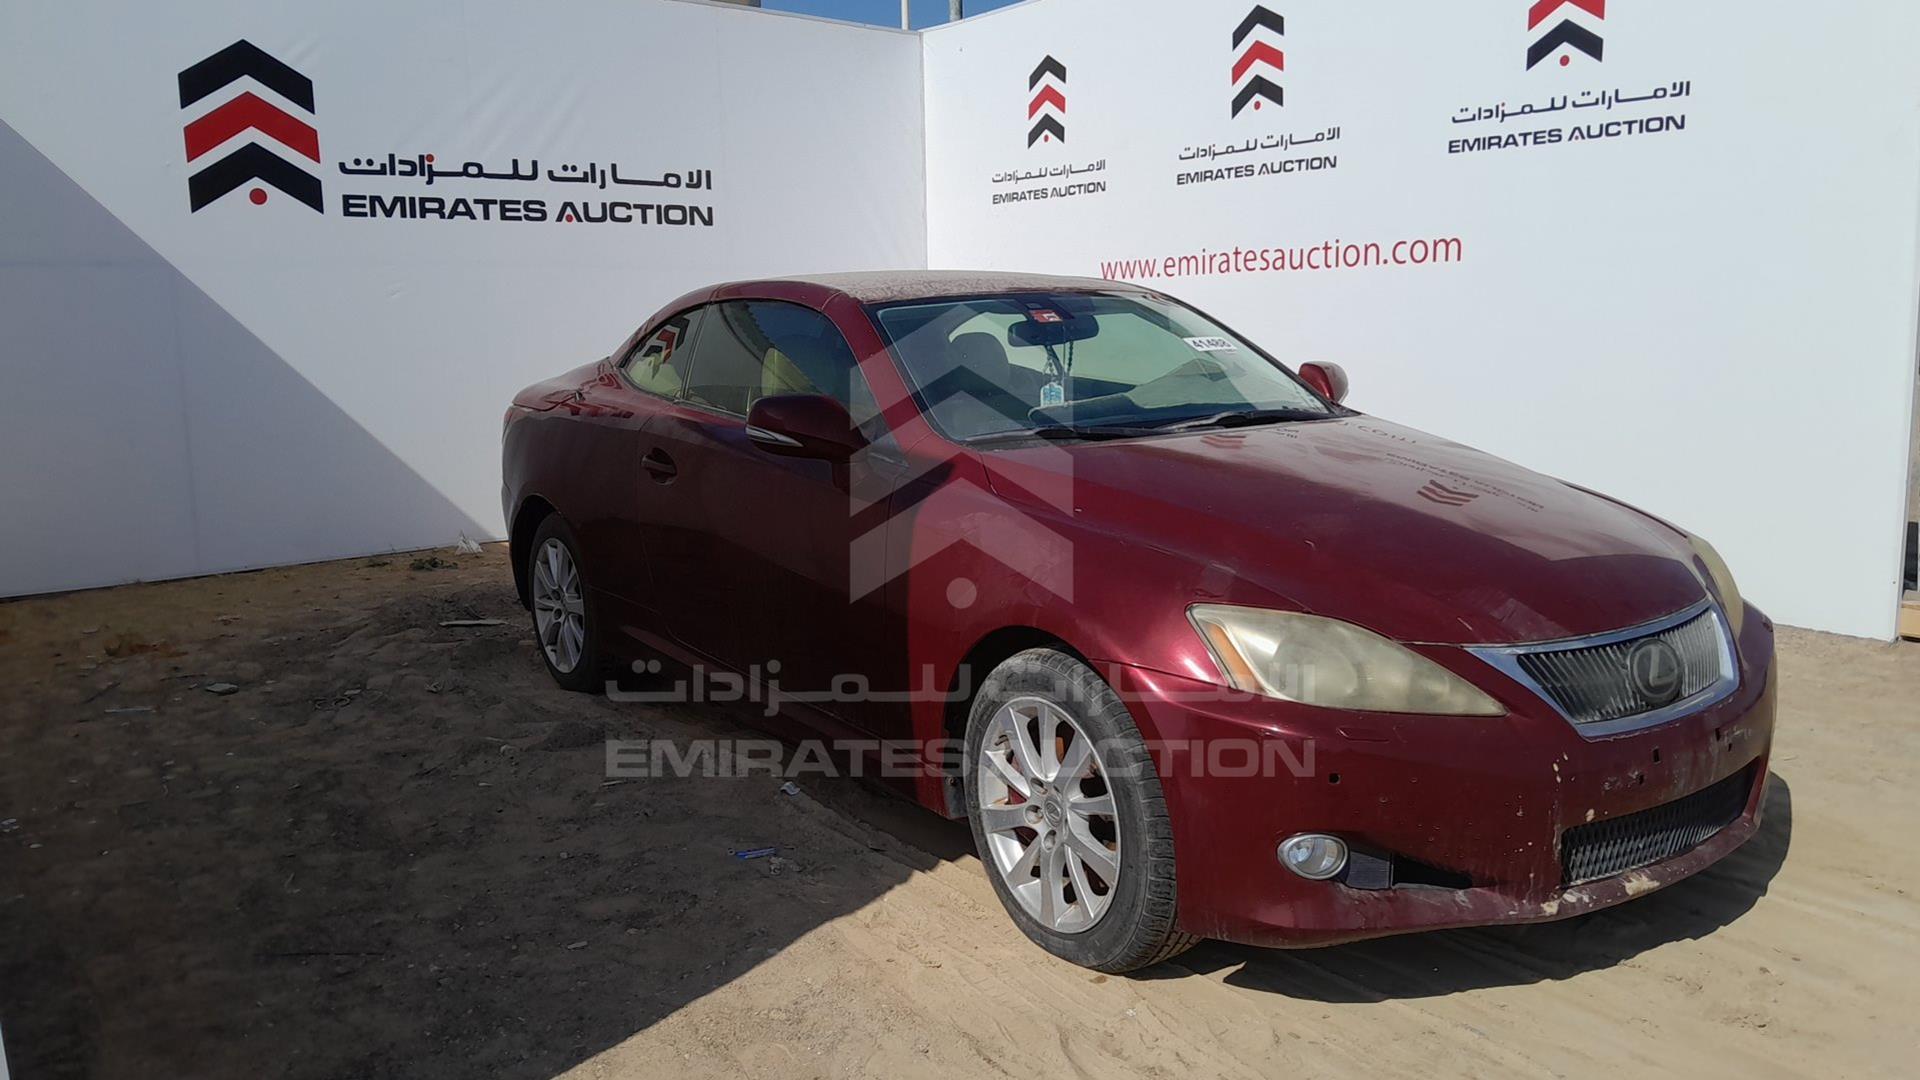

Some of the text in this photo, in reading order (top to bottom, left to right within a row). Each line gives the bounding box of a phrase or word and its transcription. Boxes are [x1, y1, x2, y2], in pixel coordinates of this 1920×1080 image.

[1447, 114, 1686, 154] EMIRATES AUCTION
[1176, 155, 1338, 186] EMIRATES AUCTION
[992, 180, 1107, 205] EMIRATES AUCTION
[341, 194, 714, 226] EMIRATES AUCTION
[1100, 237, 1462, 280] www.emiratesauction.com
